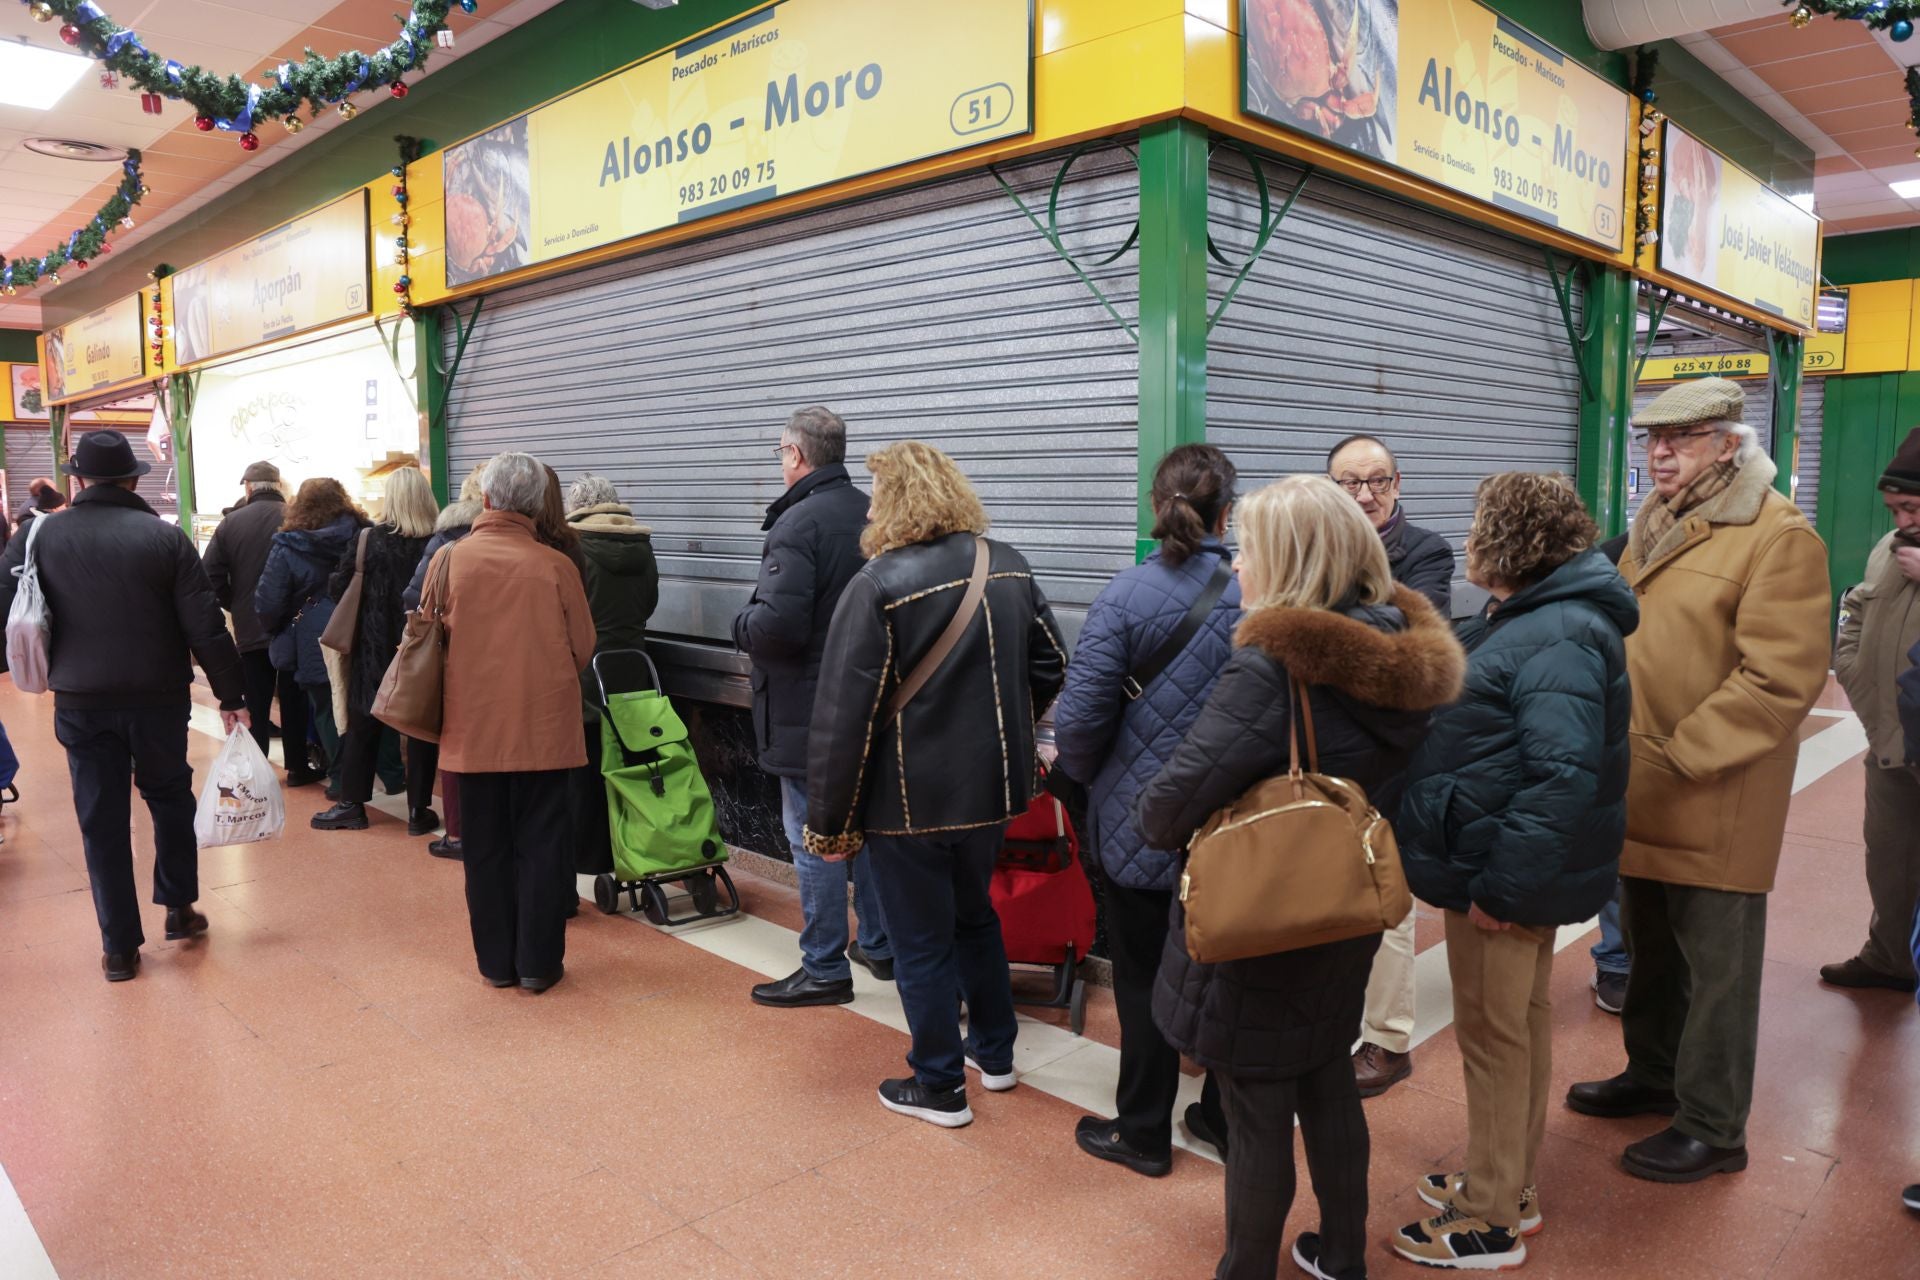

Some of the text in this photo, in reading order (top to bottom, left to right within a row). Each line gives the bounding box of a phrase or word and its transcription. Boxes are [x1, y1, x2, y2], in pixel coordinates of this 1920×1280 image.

[672, 54, 718, 81] Pescados
[730, 28, 779, 57] Mariscos
[1493, 34, 1528, 67] Pescados
[1535, 59, 1565, 88] Mariscos
[600, 62, 883, 187] Alonso - Moro
[968, 95, 991, 124] 51
[1418, 57, 1610, 189] Alonso - Moro
[1413, 140, 1439, 161] Servicio
[1446, 153, 1475, 175] Domicilio
[679, 159, 775, 205] 983 20 09 75
[1494, 166, 1558, 209] 983 20 09 75
[543, 232, 566, 247] Servicio
[571, 223, 599, 239] Domicilio
[1600, 214, 1610, 230] 51
[1720, 213, 1813, 288] José Javier Velázquez
[252, 266, 302, 312] Aporpán
[350, 289, 359, 305] 50
[86, 341, 110, 364] Galindo
[1673, 362, 1695, 372] 625
[1698, 361, 1713, 371] 47
[1736, 359, 1751, 368] 88
[1808, 355, 1824, 365] 39
[214, 810, 266, 823] T. Marcos
